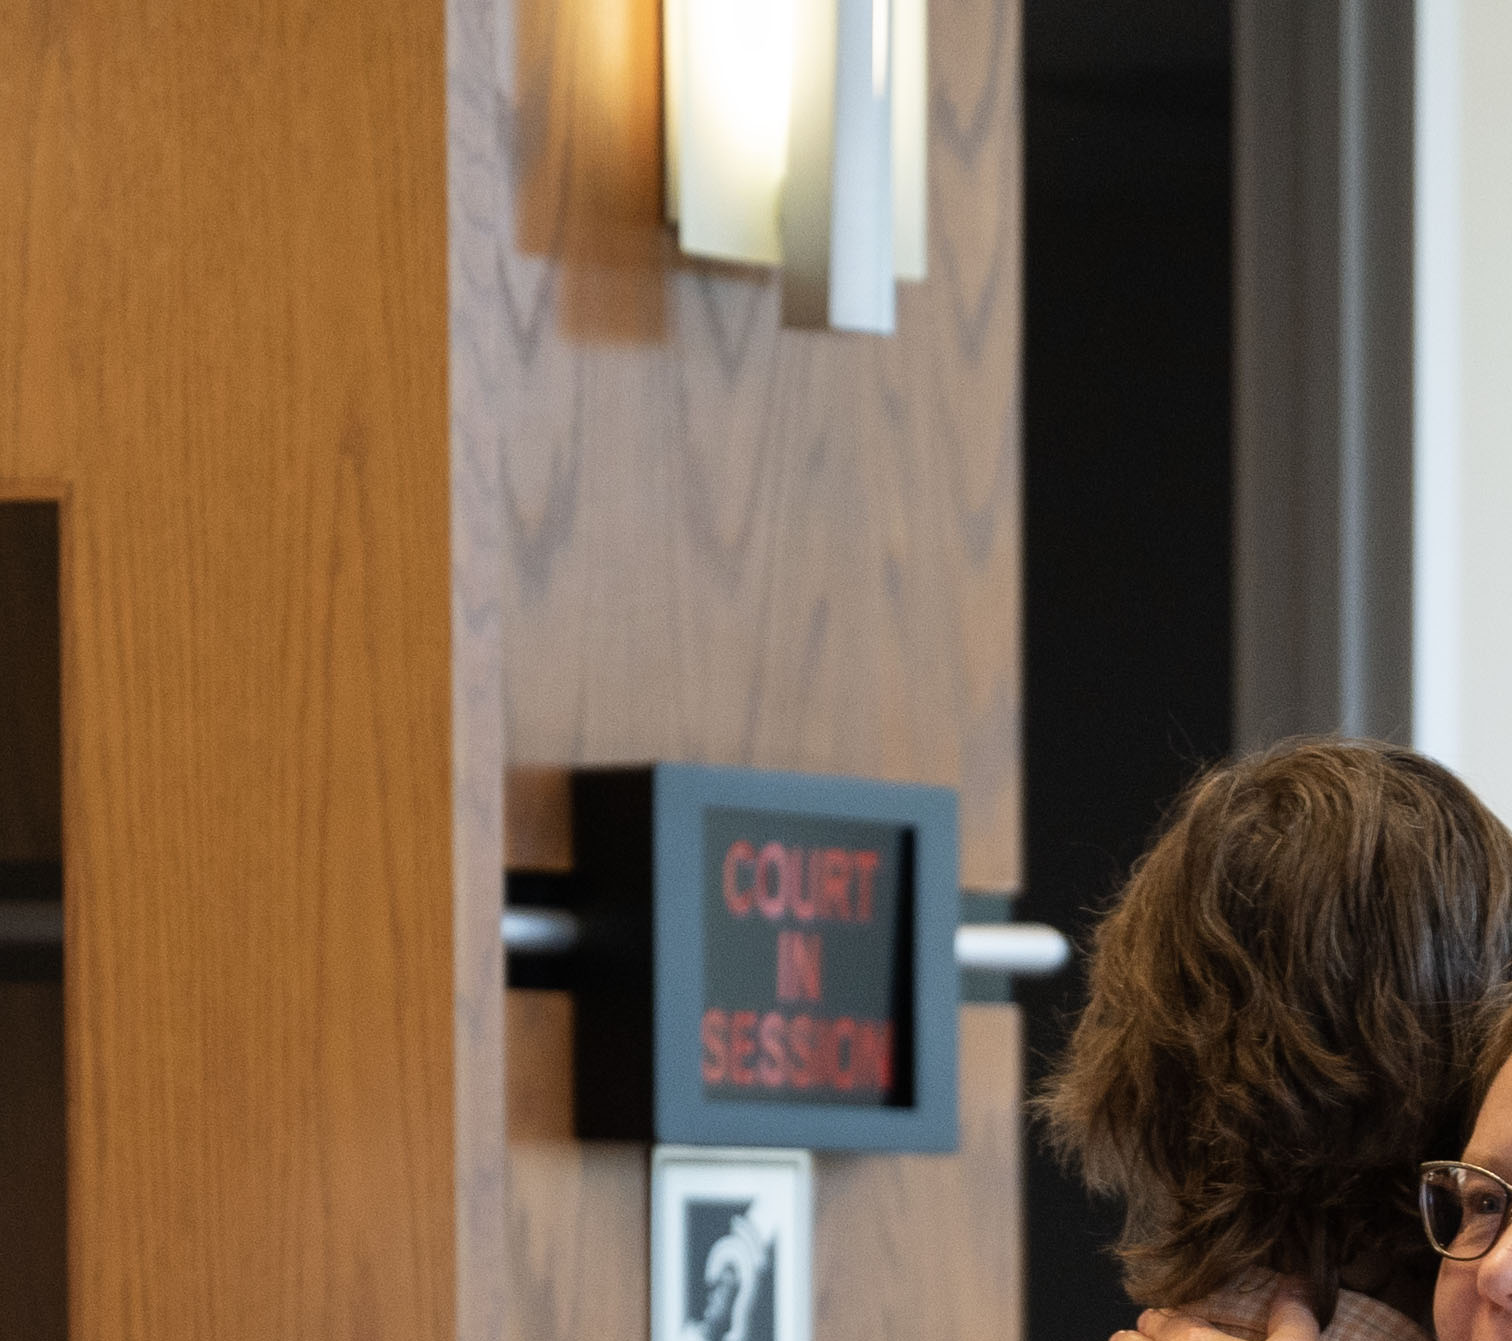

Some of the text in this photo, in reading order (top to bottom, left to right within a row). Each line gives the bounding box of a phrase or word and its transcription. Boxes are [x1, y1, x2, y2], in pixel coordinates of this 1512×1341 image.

[722, 839, 879, 923] COURT
[777, 931, 823, 1003] IN
[699, 1007, 895, 1091] SESSION
